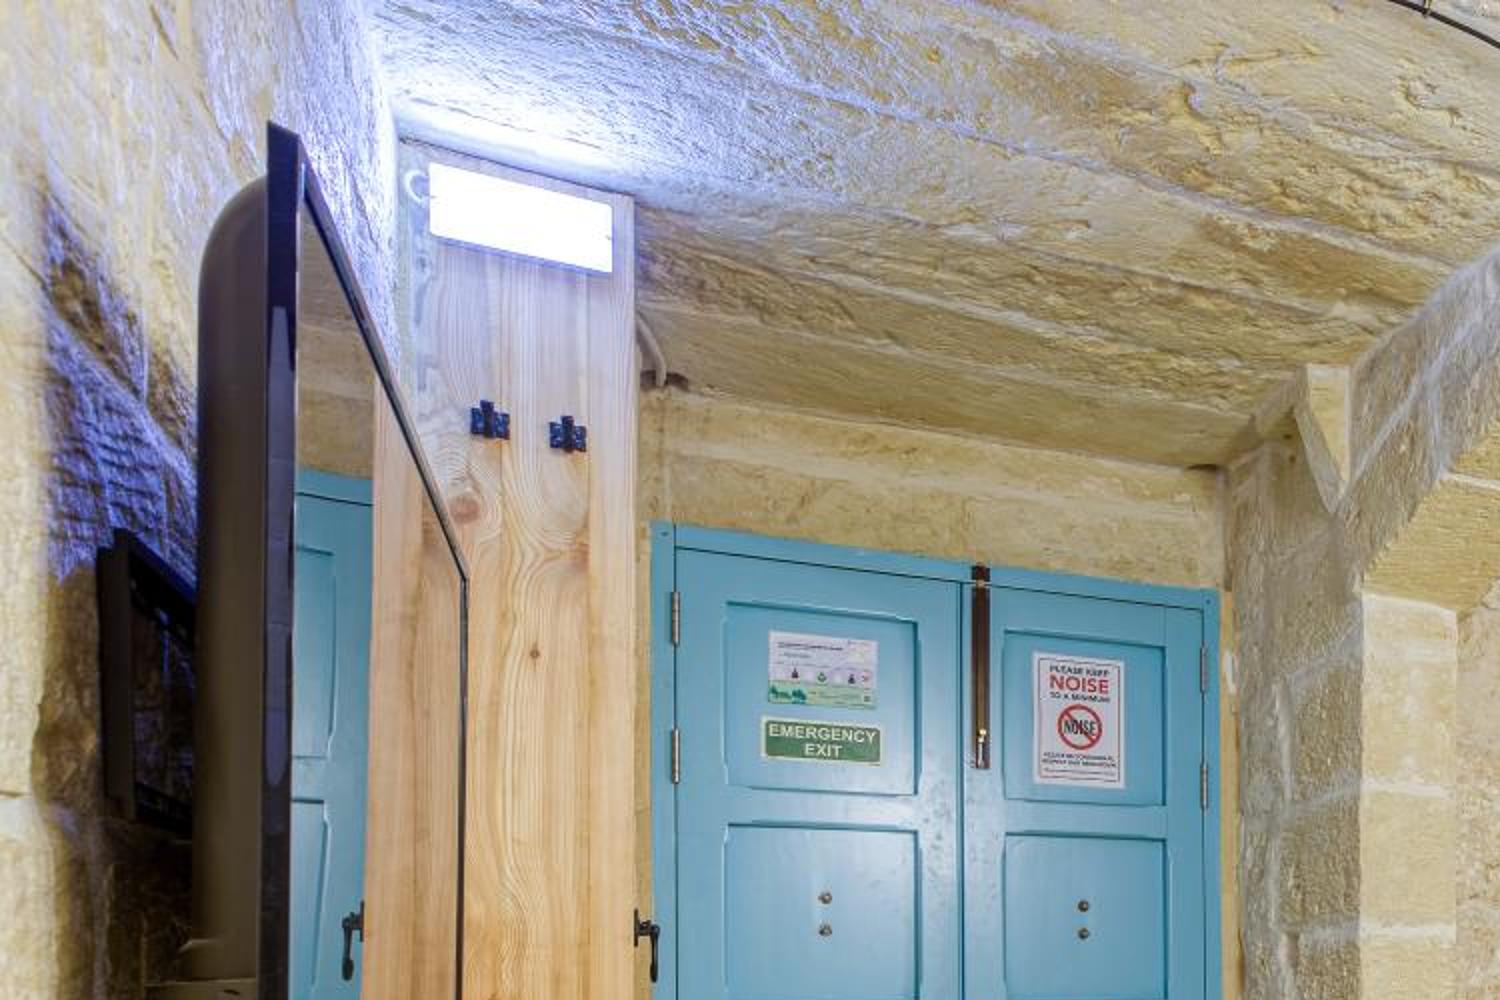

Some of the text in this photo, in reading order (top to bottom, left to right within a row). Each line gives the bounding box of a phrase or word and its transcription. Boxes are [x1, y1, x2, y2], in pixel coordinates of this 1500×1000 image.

[1049, 664, 1110, 677] PLEASE KEEP
[1049, 674, 1109, 694] NOISE
[768, 723, 877, 743] EMERGENCY
[1063, 719, 1096, 736] NOISE
[804, 743, 842, 758] EXIT
